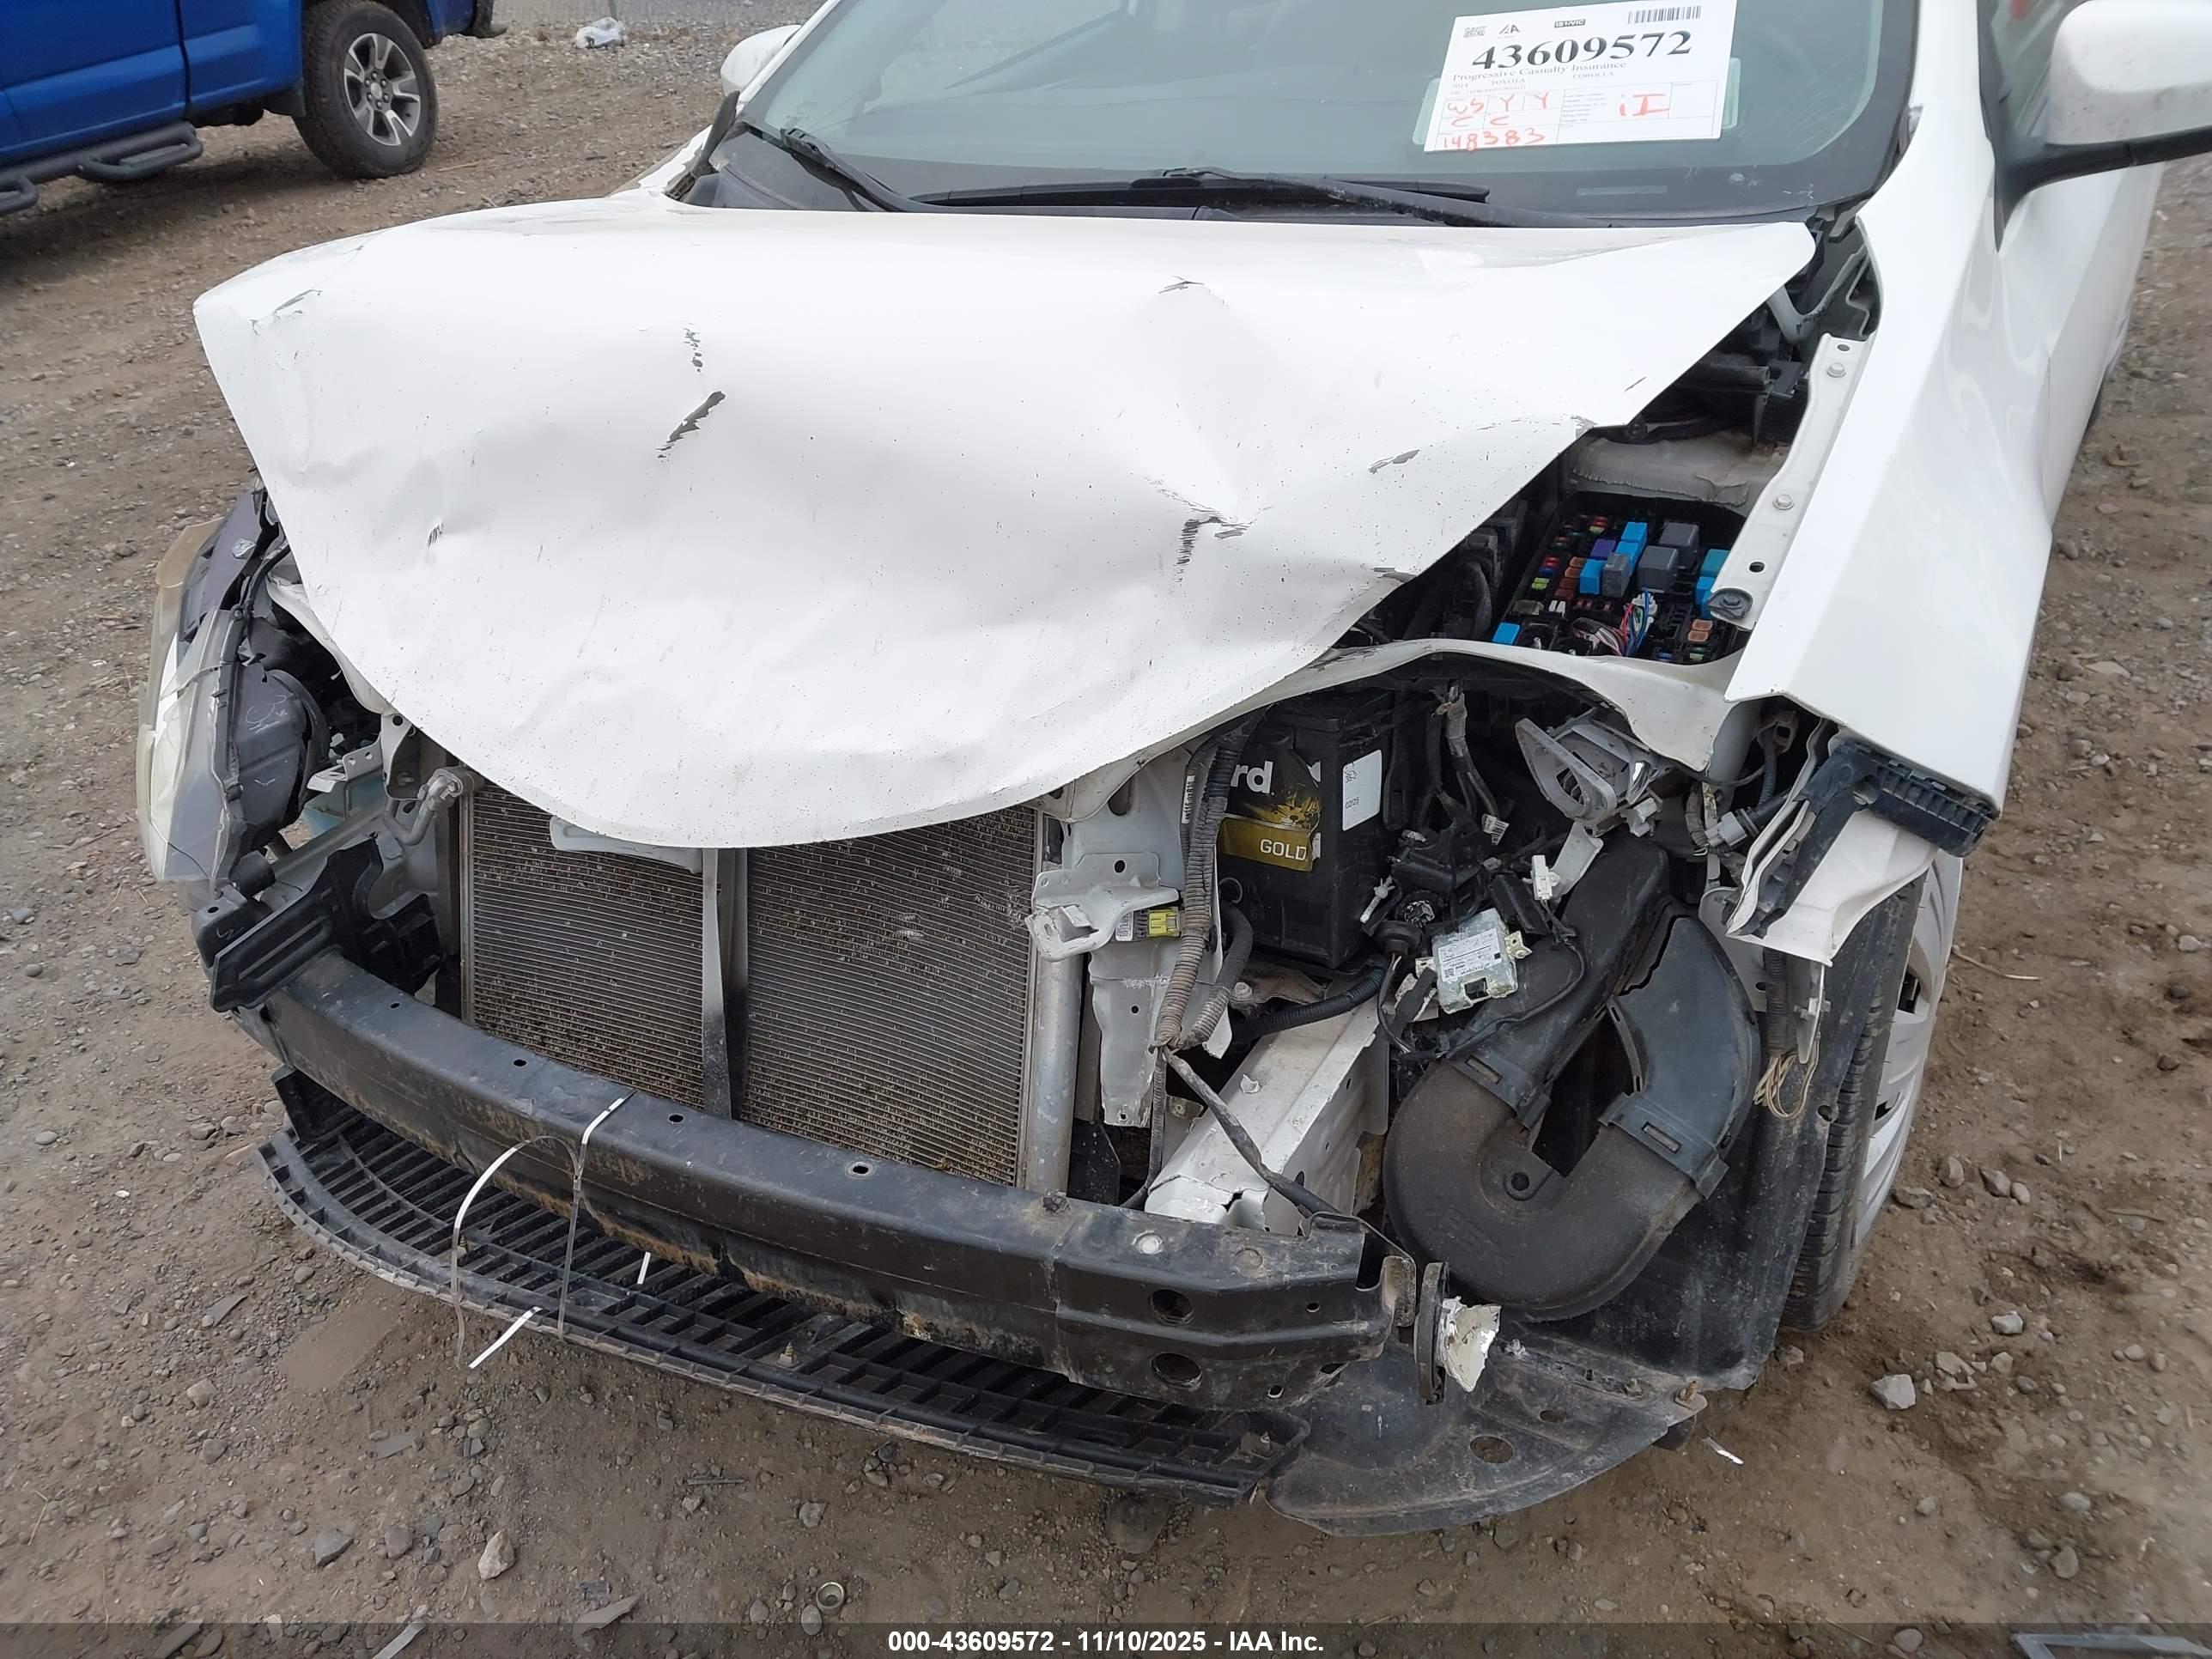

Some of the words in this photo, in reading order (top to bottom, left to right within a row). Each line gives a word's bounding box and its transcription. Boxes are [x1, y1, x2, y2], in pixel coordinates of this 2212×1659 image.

[1472, 30, 1692, 70] 43609572
[1452, 70, 1516, 82] Progressive
[1519, 65, 1568, 76] Casualty
[1572, 63, 1627, 71] Insurance
[1500, 94, 1515, 112] Y
[1534, 91, 1549, 109] Y
[1443, 127, 1545, 151] 148383
[1260, 838, 1307, 861] GOLD
